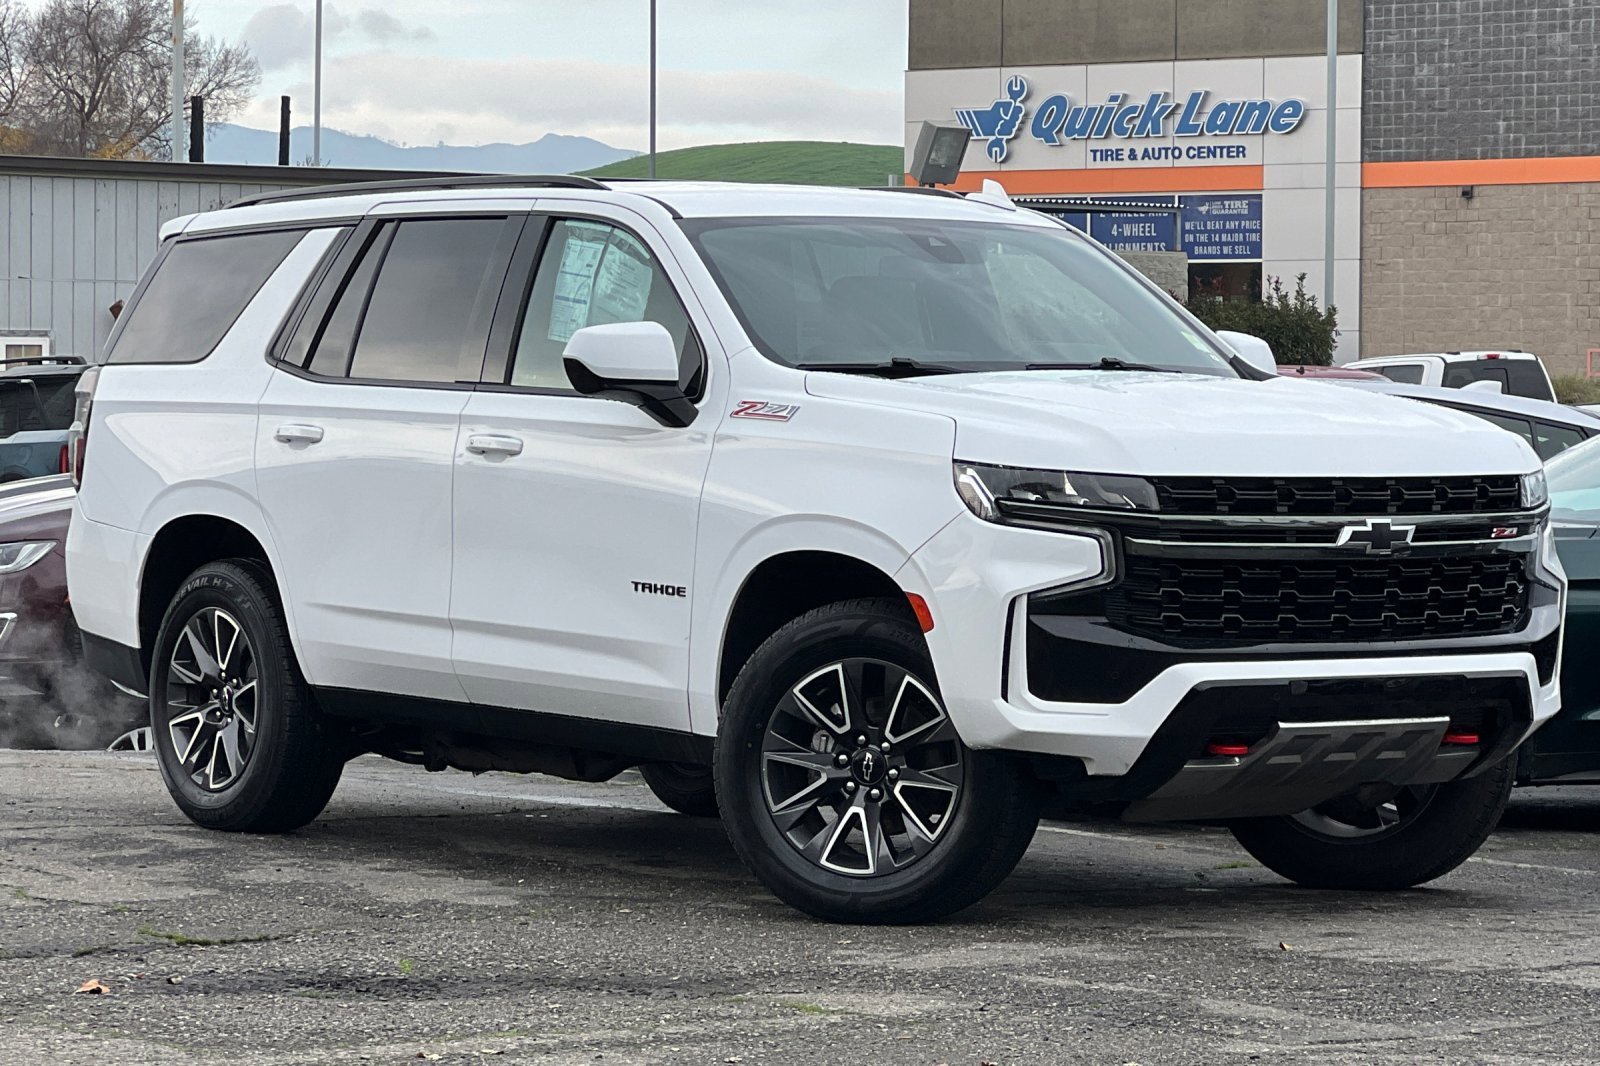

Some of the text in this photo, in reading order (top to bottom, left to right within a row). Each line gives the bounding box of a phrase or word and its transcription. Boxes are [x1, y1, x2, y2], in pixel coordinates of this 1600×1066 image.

[1031, 90, 1304, 145] Quick Lane
[1089, 145, 1246, 162] TIRE & AUTO CENTER
[1224, 200, 1249, 209] TIRE
[1111, 223, 1157, 237] 4-WHEEL
[1184, 220, 1261, 230] WE'LL BEAT ANY PRICE
[1184, 232, 1261, 243] ON THE 14 MAJOR TIRE
[1194, 245, 1251, 255] BRANDS WE SELL
[730, 400, 800, 422] Z71
[630, 580, 687, 598] TAHOE
